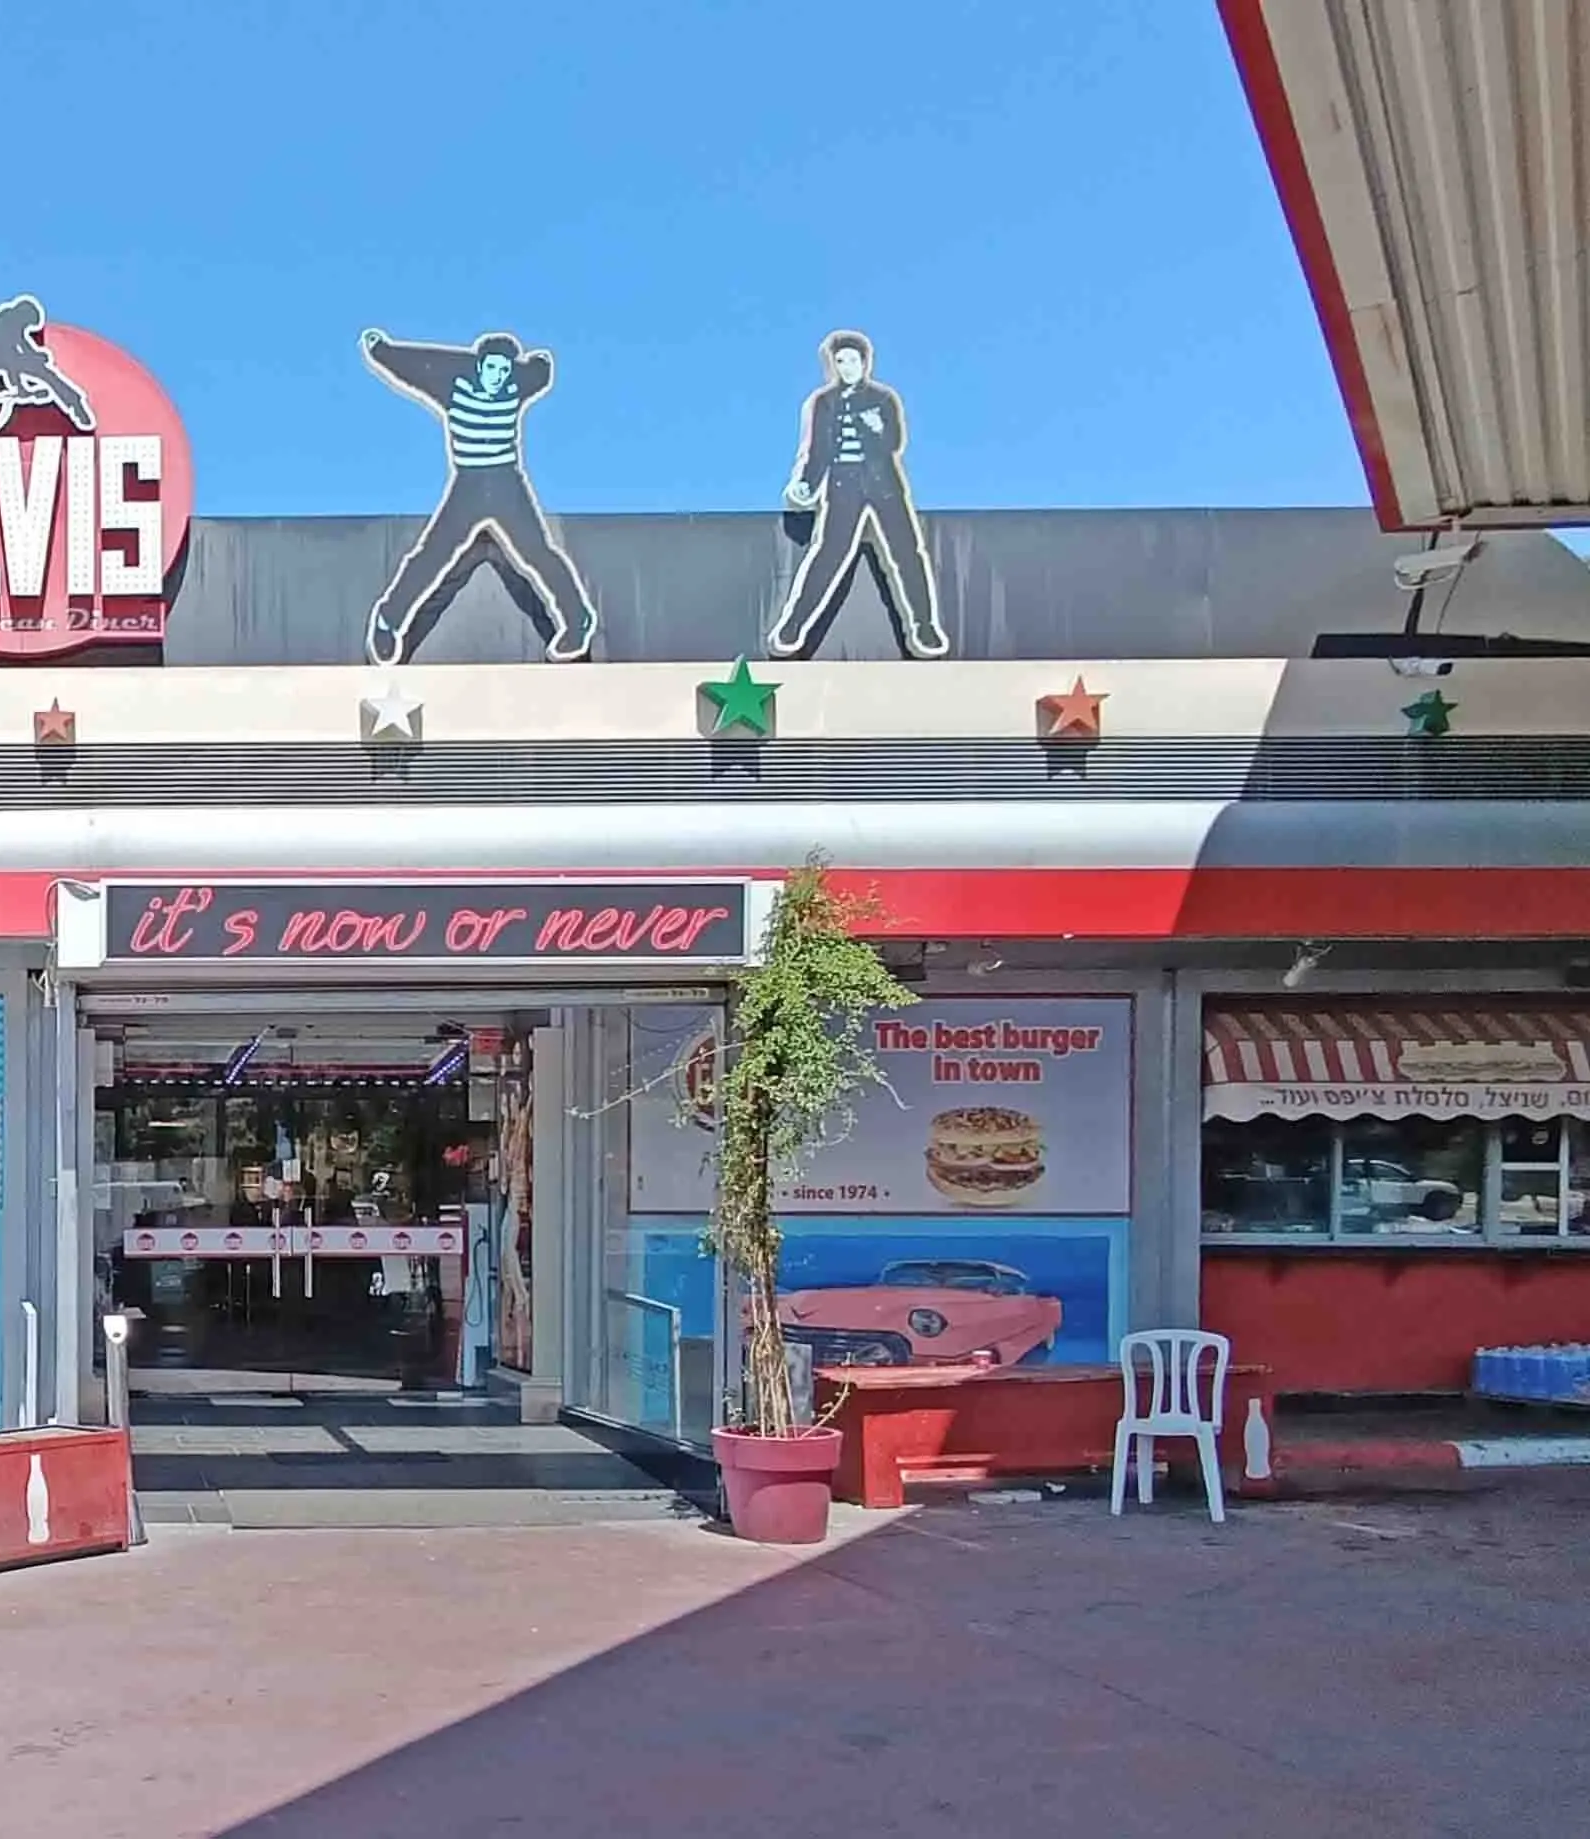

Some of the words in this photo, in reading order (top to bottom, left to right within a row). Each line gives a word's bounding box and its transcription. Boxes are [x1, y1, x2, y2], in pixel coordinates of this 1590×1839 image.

[65, 607, 160, 632] Diner
[277, 908, 427, 952] now
[444, 907, 528, 952] or
[534, 904, 729, 952] never
[874, 1021, 929, 1050] The
[933, 1020, 997, 1050] best
[1001, 1020, 1101, 1056] burger
[967, 1057, 1042, 1082] town
[792, 1184, 834, 1200] since
[838, 1184, 878, 1200] 1974
